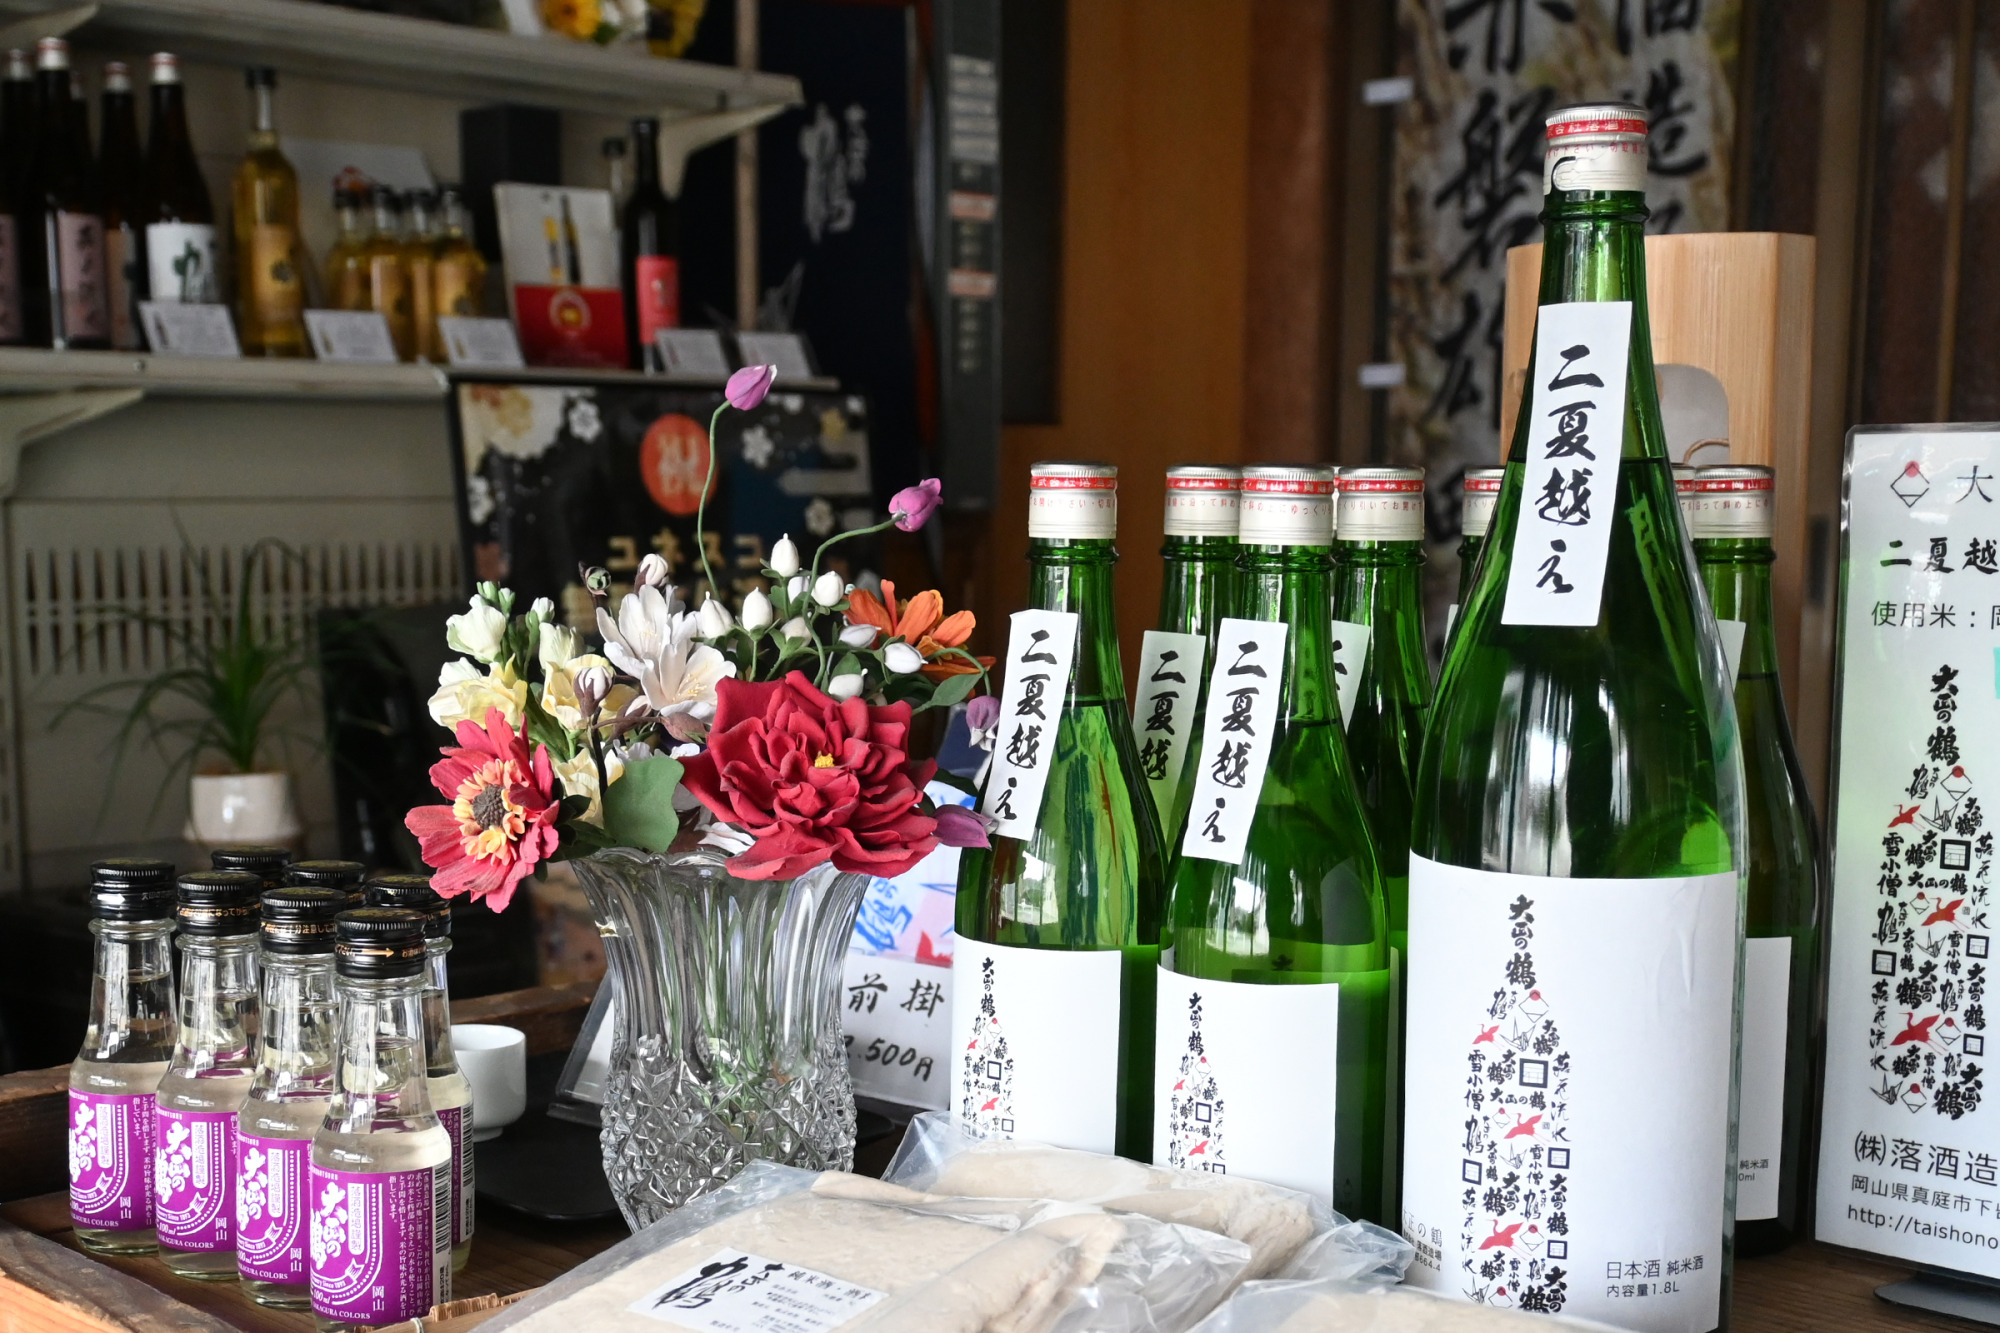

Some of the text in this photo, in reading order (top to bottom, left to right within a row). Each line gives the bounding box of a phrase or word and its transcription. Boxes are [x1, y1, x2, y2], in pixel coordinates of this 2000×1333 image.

[1535, 345, 1604, 594] 二夏越え
[1955, 465, 1994, 504] 大
[1879, 536, 2000, 575] 二夏越
[994, 629, 1057, 820] 二夏越え
[1201, 641, 1267, 843] 二夏越え
[1926, 664, 1960, 767] 大正の鶴
[1877, 832, 1904, 898] 雪小僧
[1907, 871, 1969, 896] 大正の鶴
[1505, 894, 1537, 990] 大正の鶴
[981, 957, 996, 1017] 大正の鶴
[1963, 963, 1987, 1031] 大正の鶴
[1188, 992, 1205, 1056] 大正の鶴
[1464, 1049, 1486, 1111] 雪小僧
[1490, 1087, 1547, 1111] 大正の鶴
[120, 1196, 132, 1219] 岡山
[1547, 1173, 1569, 1236] 大正の鶴
[1851, 1174, 2000, 1220] 岡山県真庭市下
[215, 1217, 227, 1241] 岡山
[290, 1248, 302, 1272] 岡山
[1607, 1255, 1704, 1279] 日本酒 純米酒
[373, 1285, 384, 1311] 岡山
[1607, 1281, 1680, 1297] 内容量1.8L
